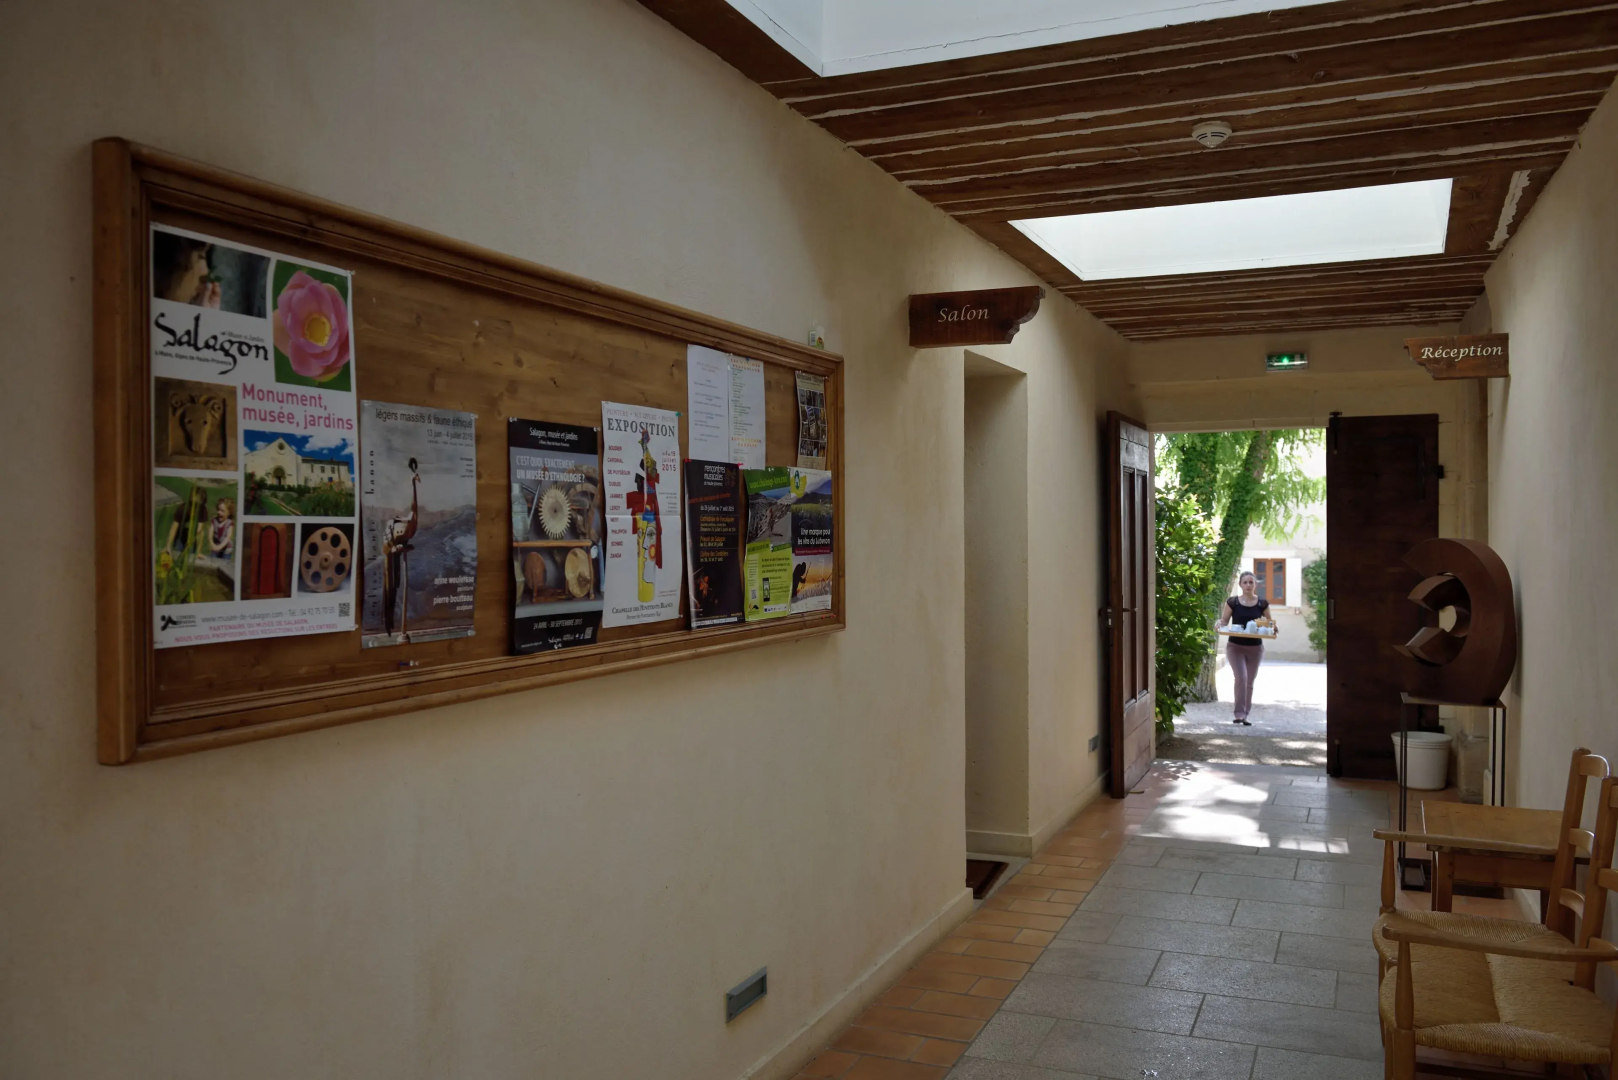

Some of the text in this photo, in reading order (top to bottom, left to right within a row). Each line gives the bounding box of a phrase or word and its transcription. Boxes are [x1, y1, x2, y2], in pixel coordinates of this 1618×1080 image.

[937, 304, 990, 323] Salon
[154, 312, 268, 375] Salagon
[1420, 344, 1504, 362] Réception
[242, 382, 328, 411] Monument,
[242, 406, 354, 430] musée, jardins
[376, 409, 473, 429] légers massifs & faune éthique
[606, 408, 676, 424] PEINTURE SCULPTURE PHOTO
[606, 418, 675, 438] EXPOSITION
[516, 455, 530, 466] C'EST
[662, 464, 676, 472] 2015
[516, 469, 526, 479] UN
[433, 595, 449, 606] pierre
[174, 635, 192, 643] NOUS
